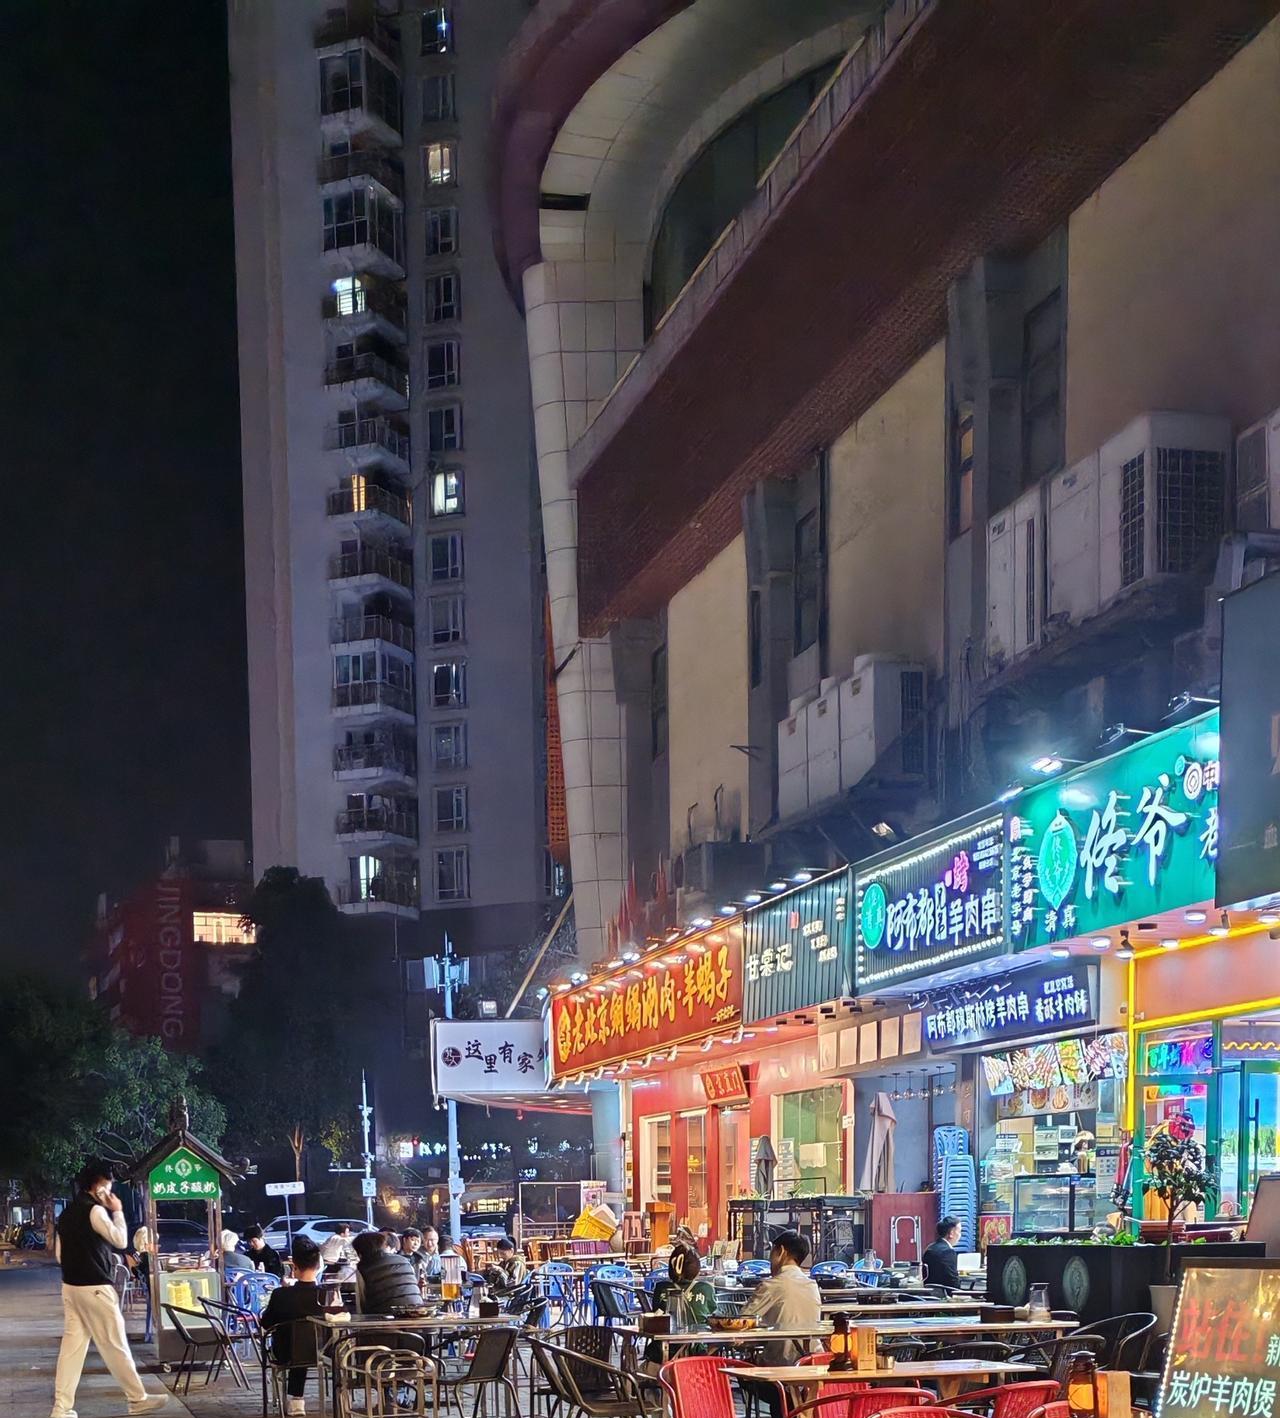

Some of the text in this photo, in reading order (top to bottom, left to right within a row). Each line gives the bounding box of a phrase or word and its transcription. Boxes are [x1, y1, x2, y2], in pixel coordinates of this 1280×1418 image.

[1080, 773, 1186, 900] 佟爷
[1045, 904, 1075, 932] 清真
[156, 882, 184, 1037] JINGDONG
[747, 943, 793, 981] 甘棠记
[153, 1181, 216, 1194] 奶皮子酸奶
[1166, 1369, 1277, 1418] 炭炉羊肉煲
